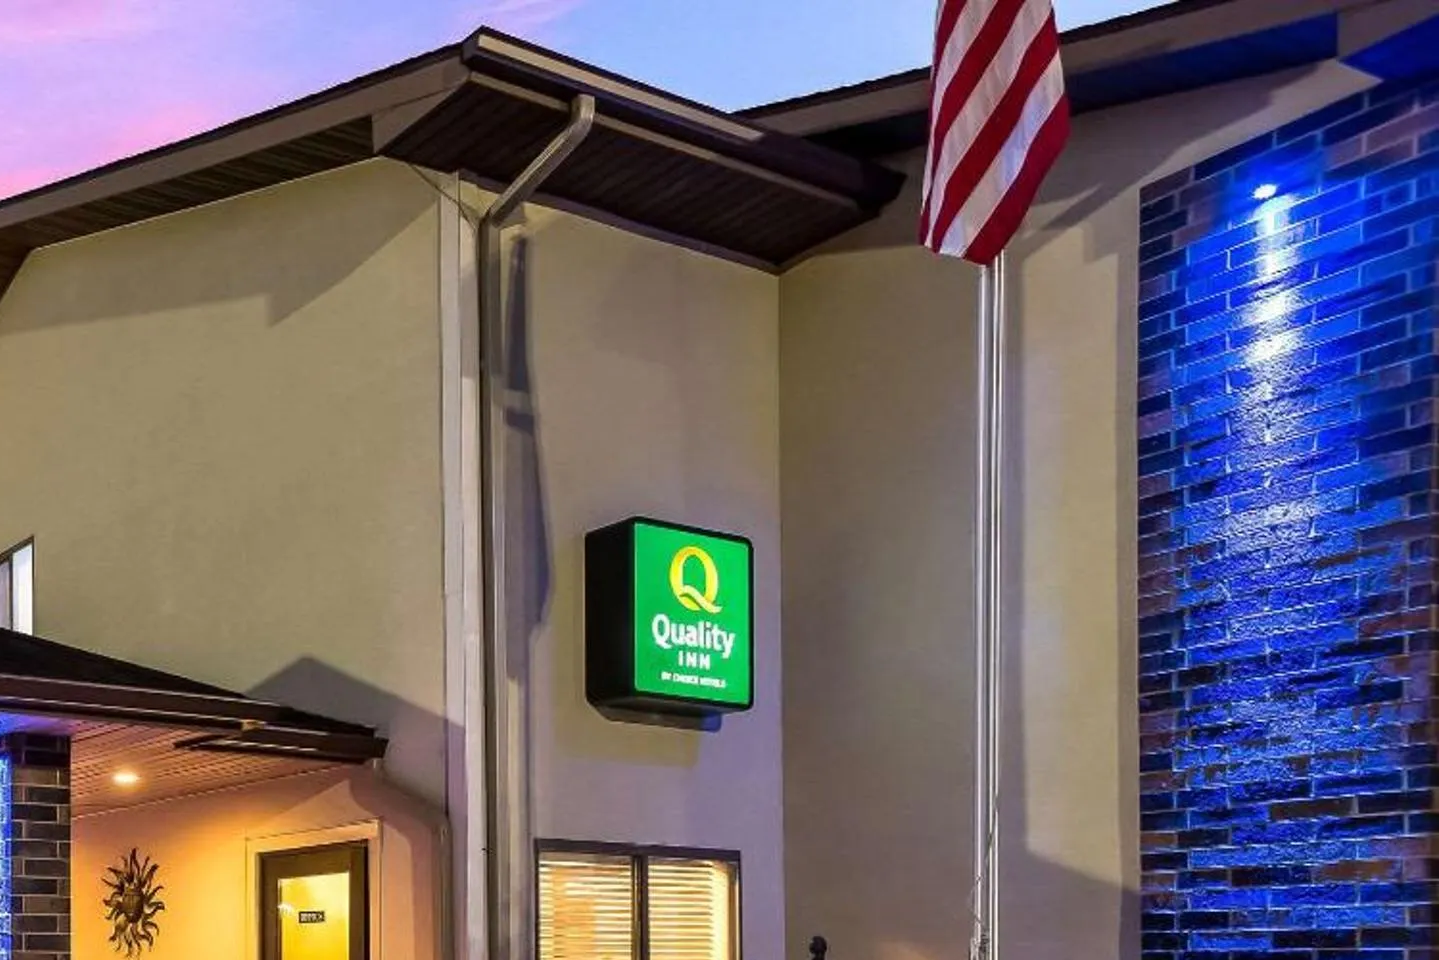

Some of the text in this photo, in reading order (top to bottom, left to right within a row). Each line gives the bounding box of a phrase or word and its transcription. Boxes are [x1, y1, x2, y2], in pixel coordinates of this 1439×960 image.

[669, 546, 723, 613] Q
[652, 613, 736, 659] Quality
[678, 650, 711, 670] INN
